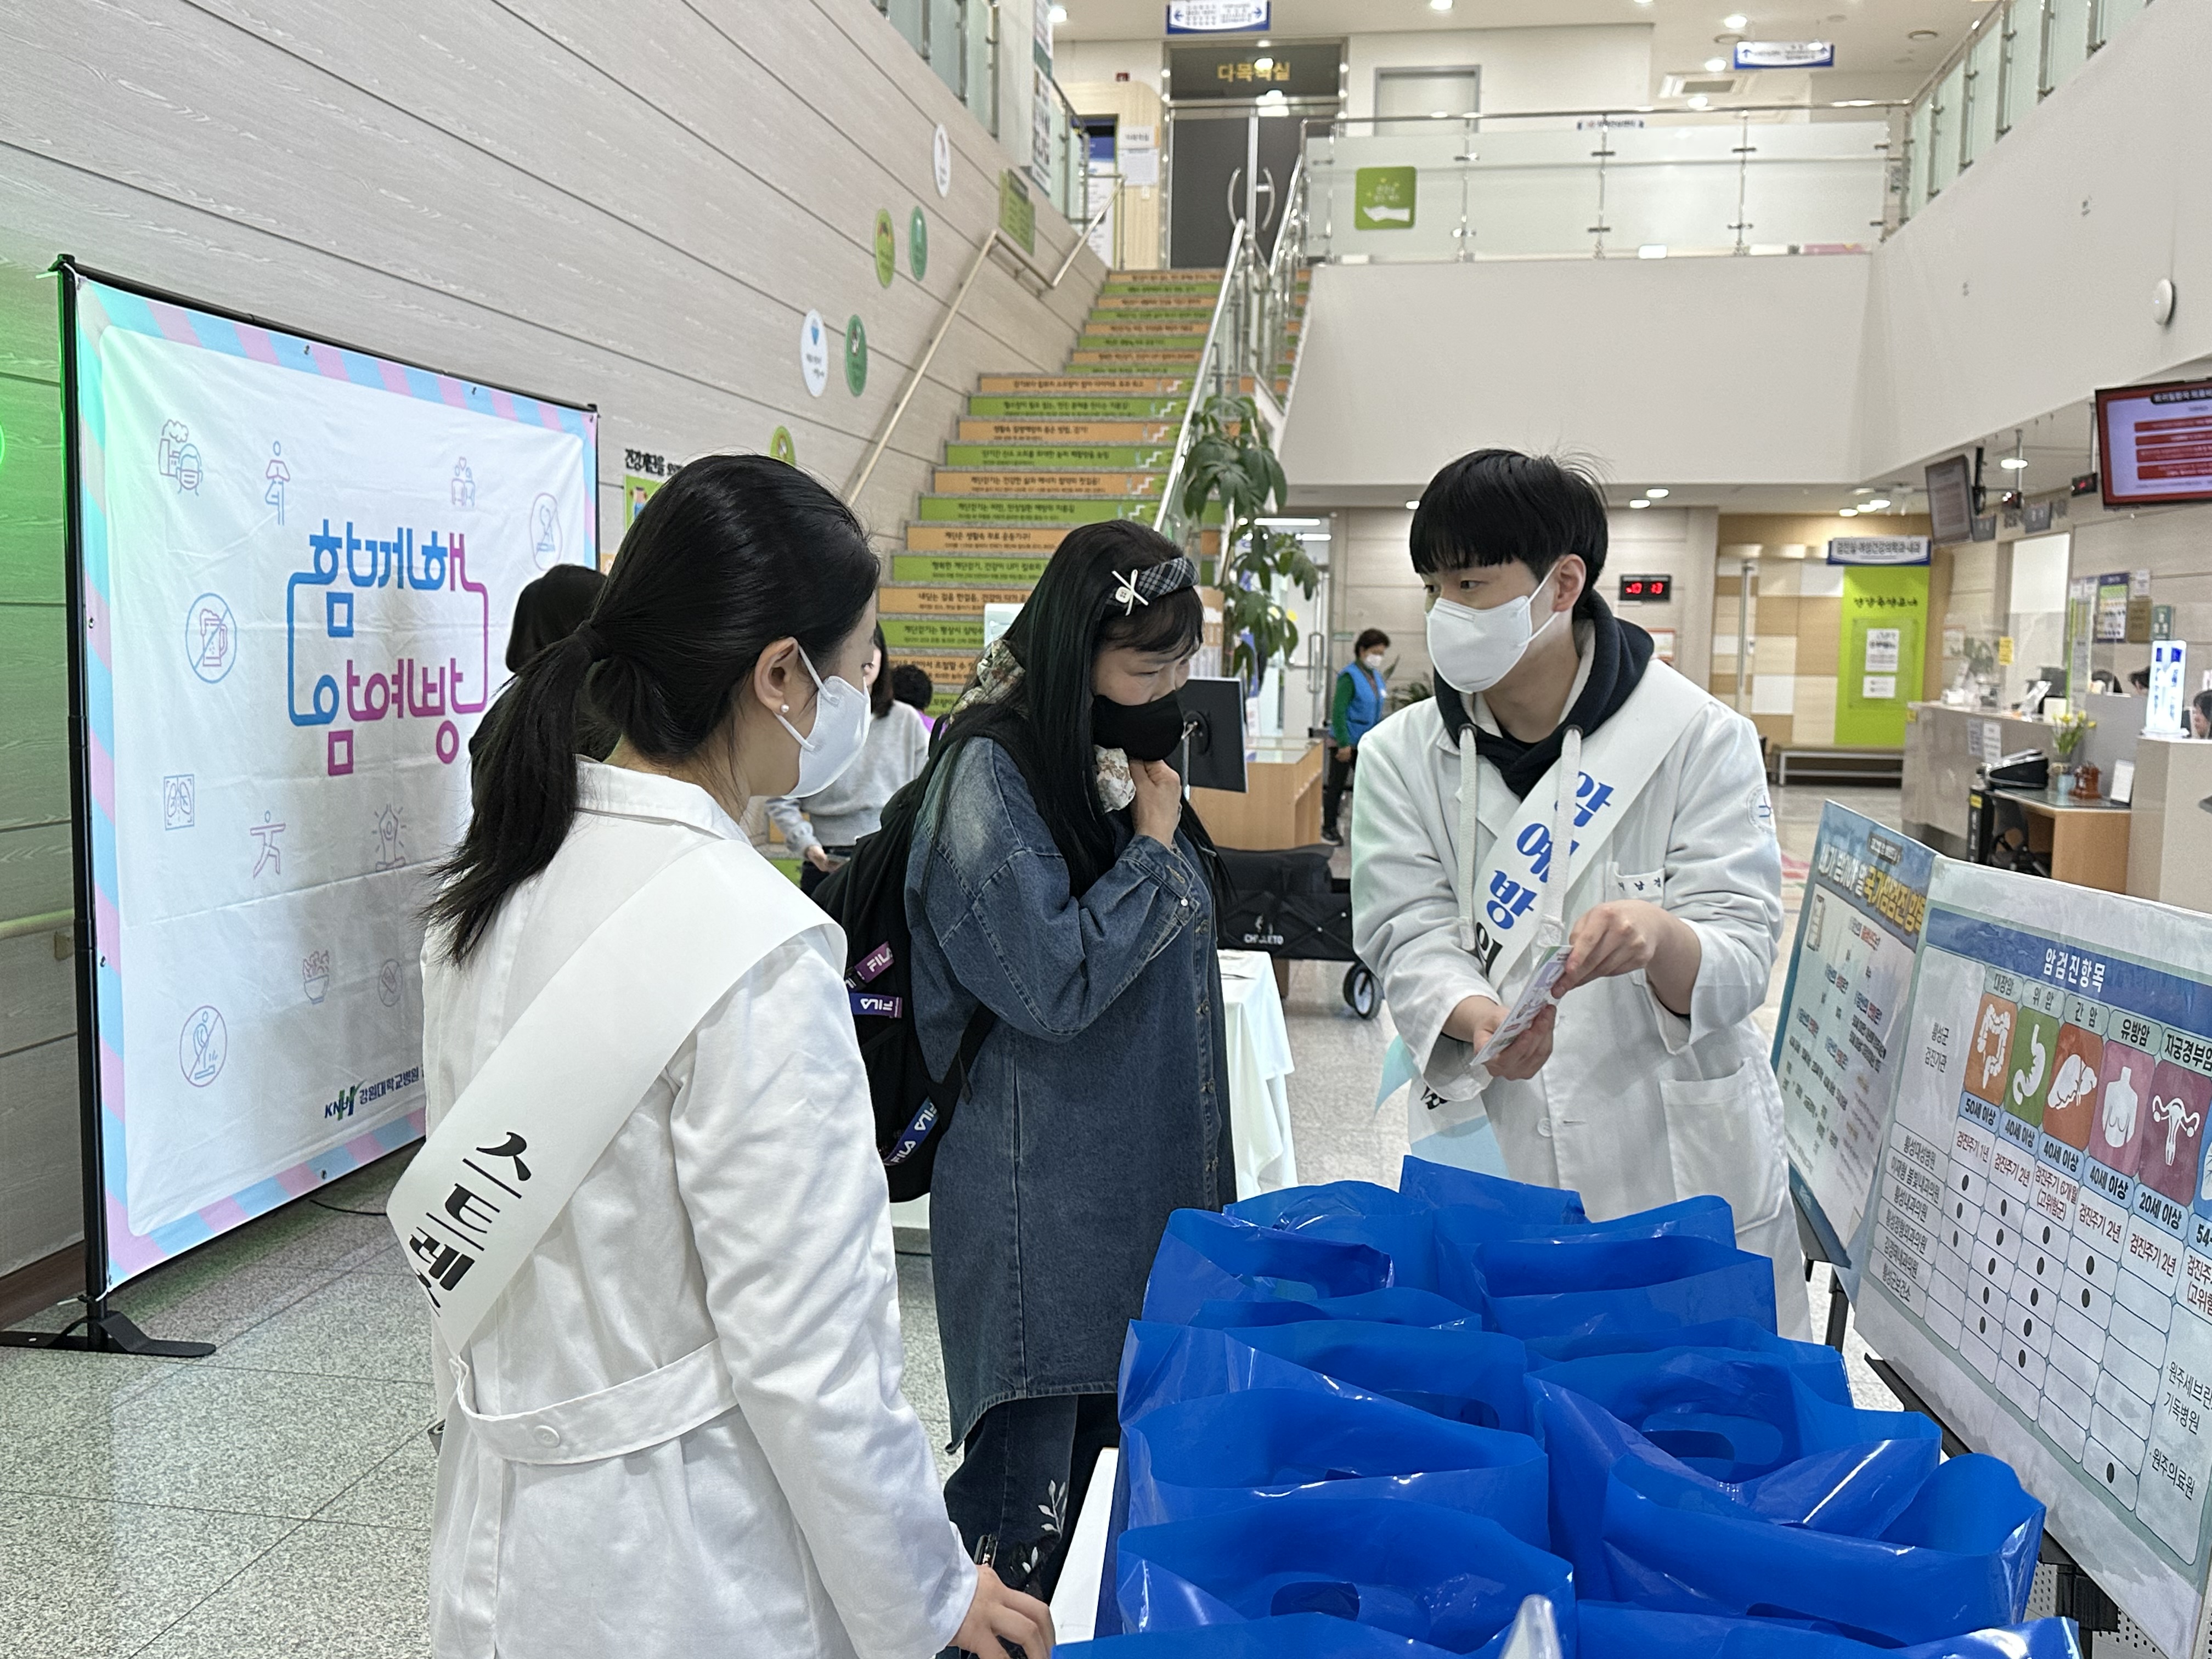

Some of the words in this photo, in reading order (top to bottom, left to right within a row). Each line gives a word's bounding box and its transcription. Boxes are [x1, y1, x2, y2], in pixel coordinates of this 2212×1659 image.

[867, 947, 894, 972] FILA
[2044, 948, 2106, 993] 암검진항목
[1993, 973, 2015, 996] 대장암
[860, 998, 894, 1011] FILA
[2121, 1019, 2151, 1047] 유방암
[359, 1066, 419, 1105] 강원대학교병원
[1965, 1098, 1982, 1119] 50세
[1982, 1106, 1996, 1126] 이상
[1956, 1131, 1979, 1158] 검진주기
[1980, 1144, 1990, 1163] 1년
[2005, 1119, 2022, 1140] 40세
[2022, 1126, 2035, 1148] 이상
[890, 1141, 916, 1163] FILA
[2044, 1141, 2063, 1164] 40세
[2062, 1150, 2079, 1172] 이상
[1994, 1153, 2019, 1181] 검진주기
[2018, 1167, 2031, 1188] 2년
[2035, 1165, 2059, 1194] 검진주기
[2090, 1165, 2109, 1190] 40세
[2108, 1176, 2129, 1200] 이상
[2079, 1203, 2106, 1235] 검진주기
[2106, 1221, 2122, 1244] 2년
[2139, 1192, 2162, 1219] 20세
[2162, 1204, 2182, 1230] 이상
[2130, 1233, 2161, 1269] 검진주기
[2160, 1253, 2177, 1278] 2년
[2187, 1255, 2212, 1286] 검진주
[2169, 1361, 2212, 1411] 원주세브란
[2164, 1392, 2200, 1435] 기독병원
[2152, 1448, 2196, 1501] 원주의료원
